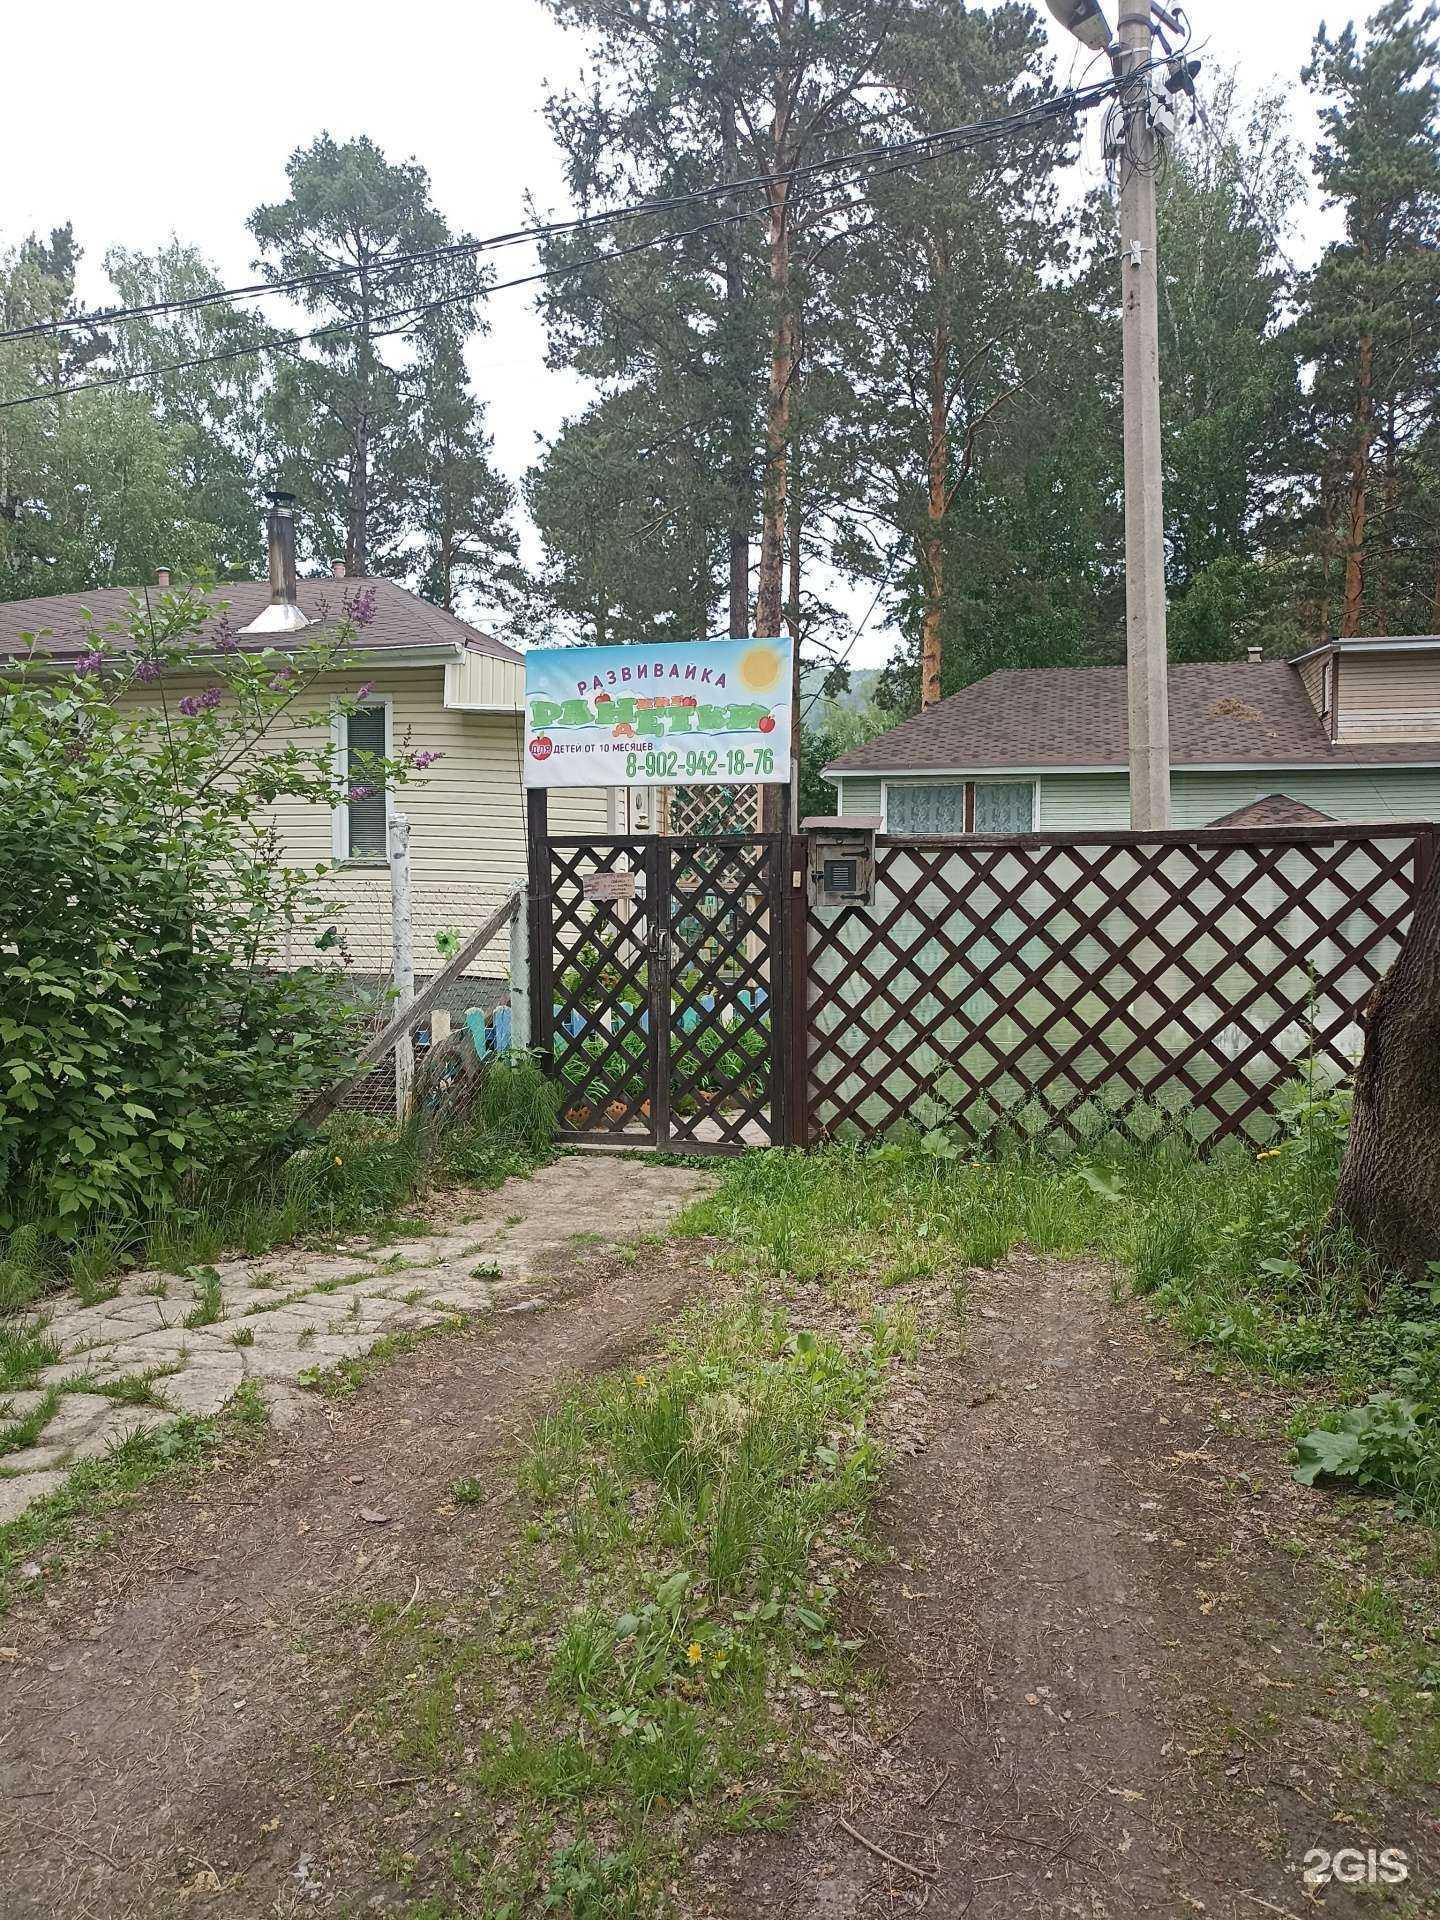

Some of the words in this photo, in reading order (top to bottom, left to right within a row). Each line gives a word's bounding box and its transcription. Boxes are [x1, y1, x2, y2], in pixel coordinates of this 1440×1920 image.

[577, 663, 727, 695] РАЗВИВАЙКА
[531, 744, 551, 755] ДЛЯ
[553, 742, 581, 754] ДЕТЕЙ
[584, 743, 596, 753] ОТ
[599, 743, 610, 753] 10
[612, 742, 654, 753] МЕСЯЦЕВ
[626, 748, 774, 778] 8-902-942-18-76
